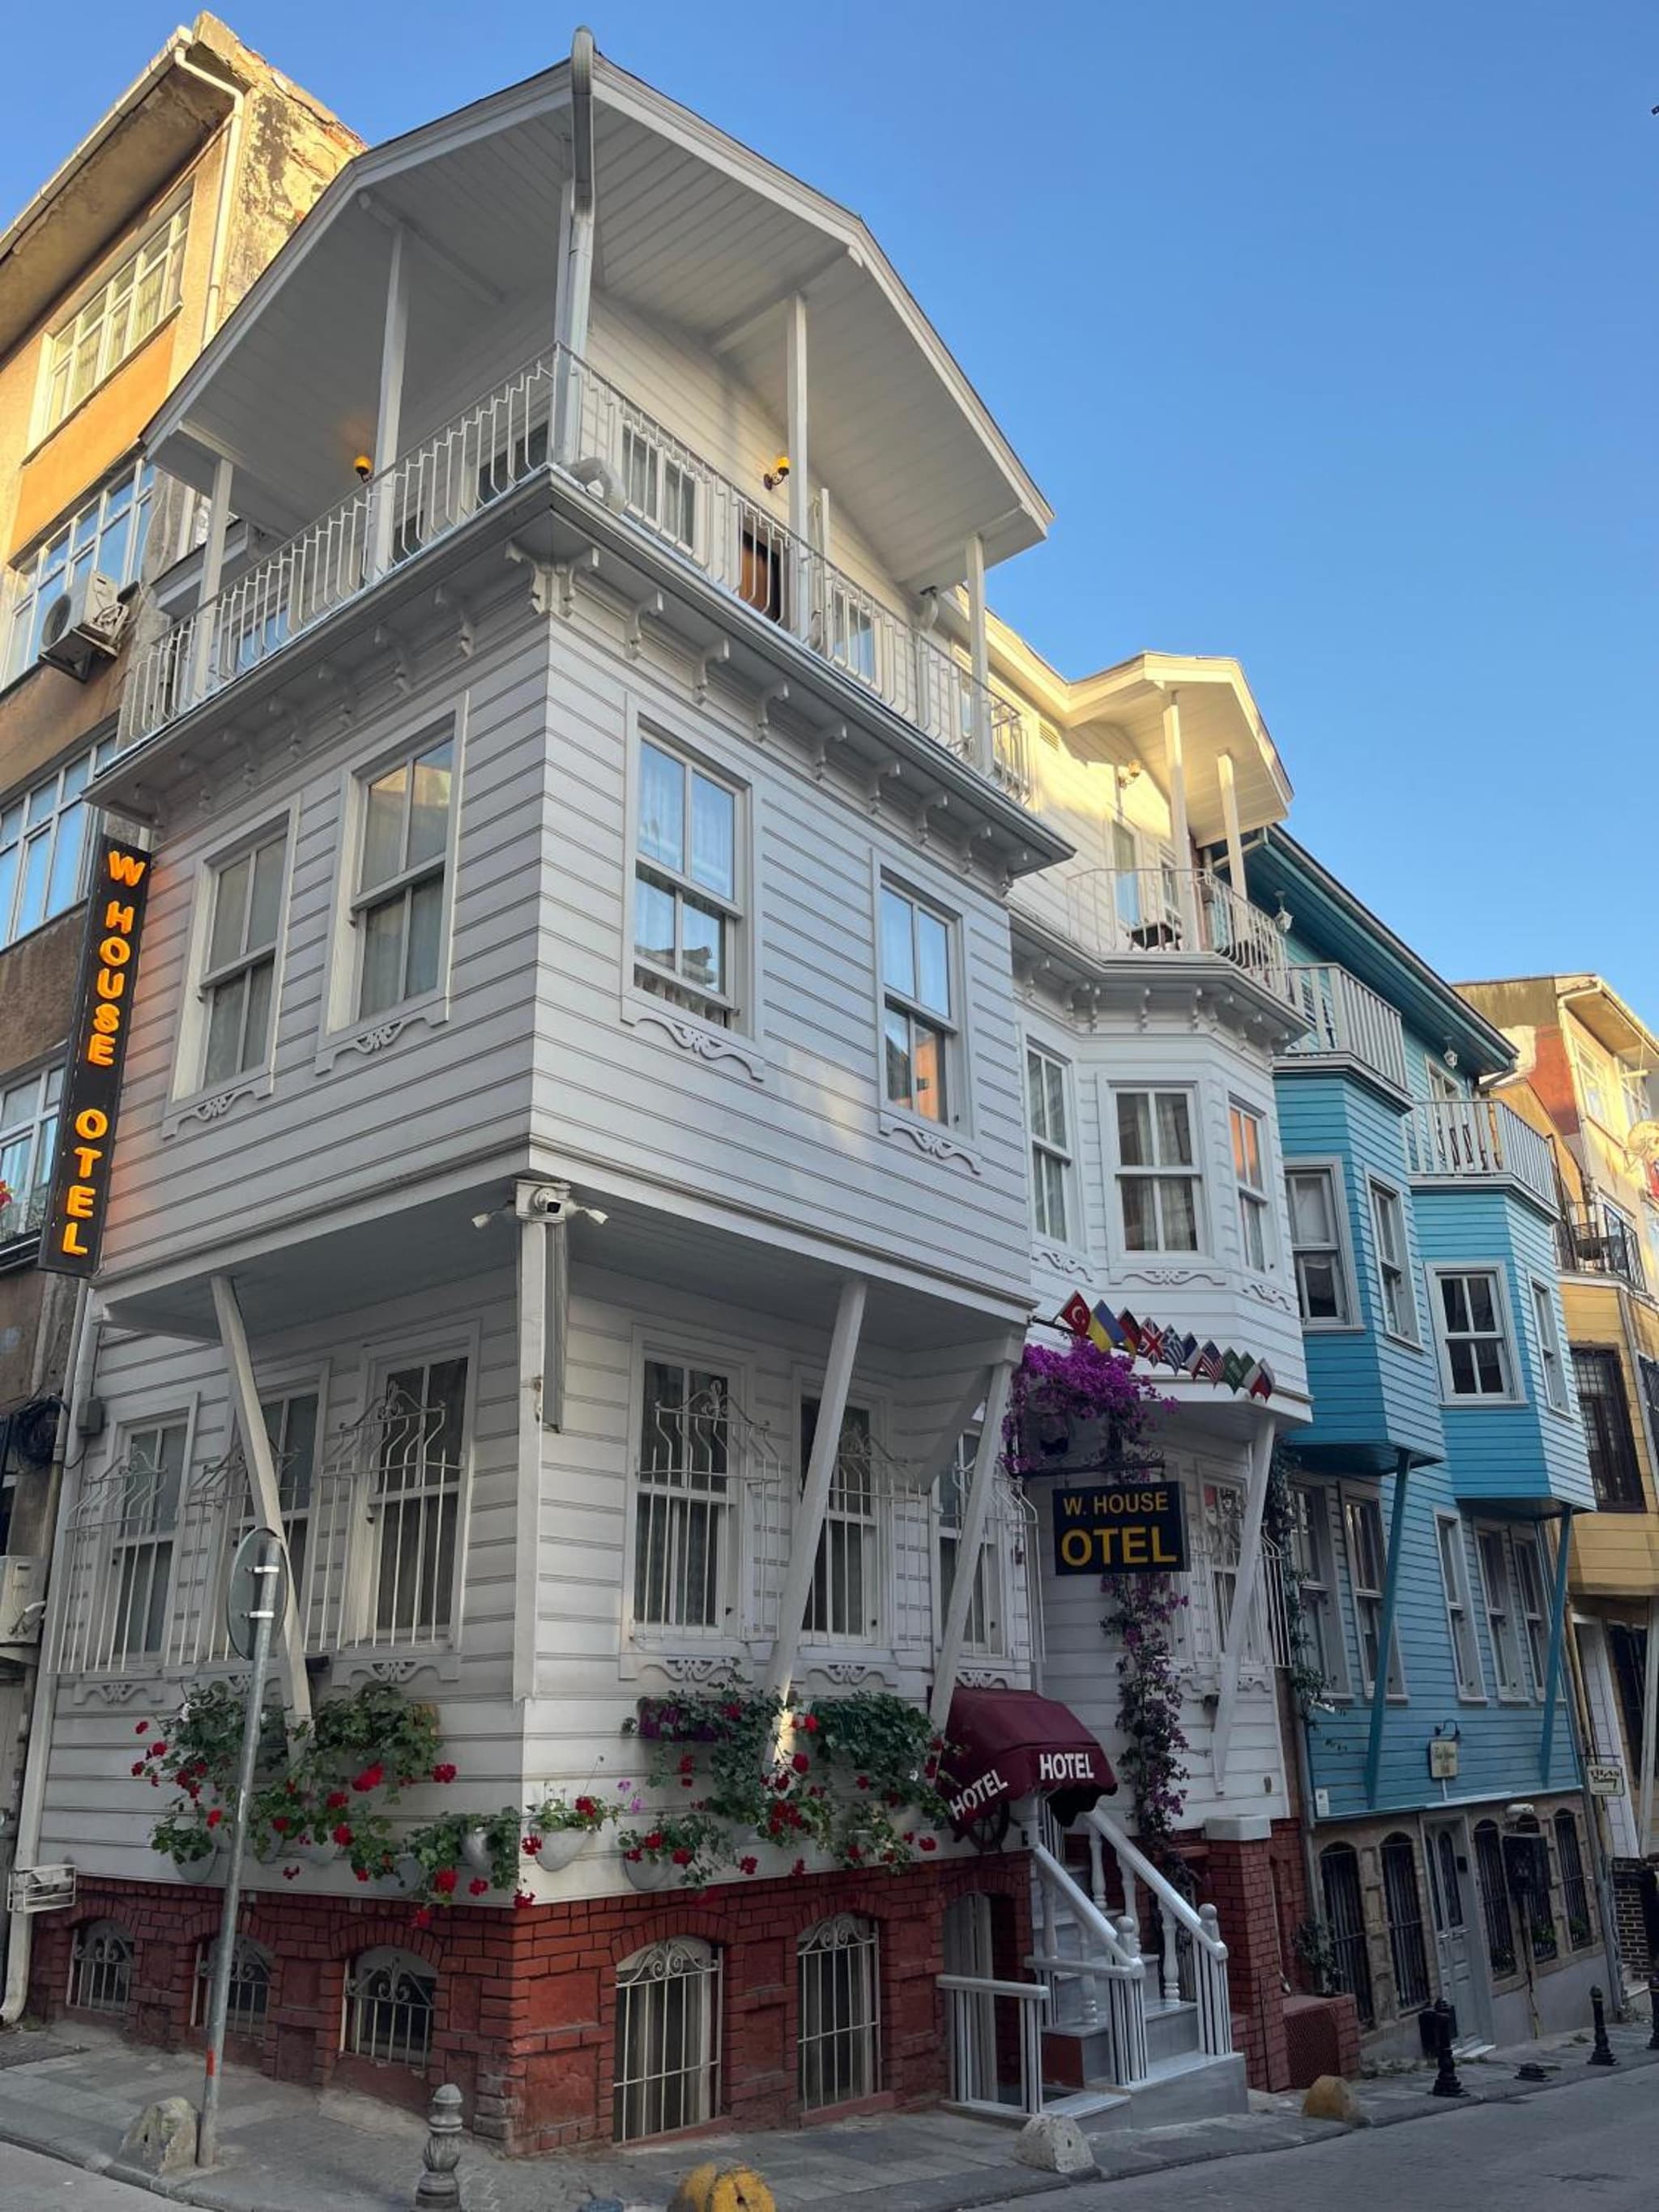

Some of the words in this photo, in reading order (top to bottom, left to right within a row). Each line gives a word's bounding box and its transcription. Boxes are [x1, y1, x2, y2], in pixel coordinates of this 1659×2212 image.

[109, 850, 146, 888] W
[87, 900, 135, 1066] HOUSE
[62, 1108, 109, 1255] OTEL
[1063, 1497, 1087, 1516] W.
[1094, 1491, 1169, 1515] HOUSE
[1061, 1526, 1178, 1567] OTEL
[1039, 1753, 1094, 1780] HOTEL
[949, 1769, 1009, 1820] HOTEL
